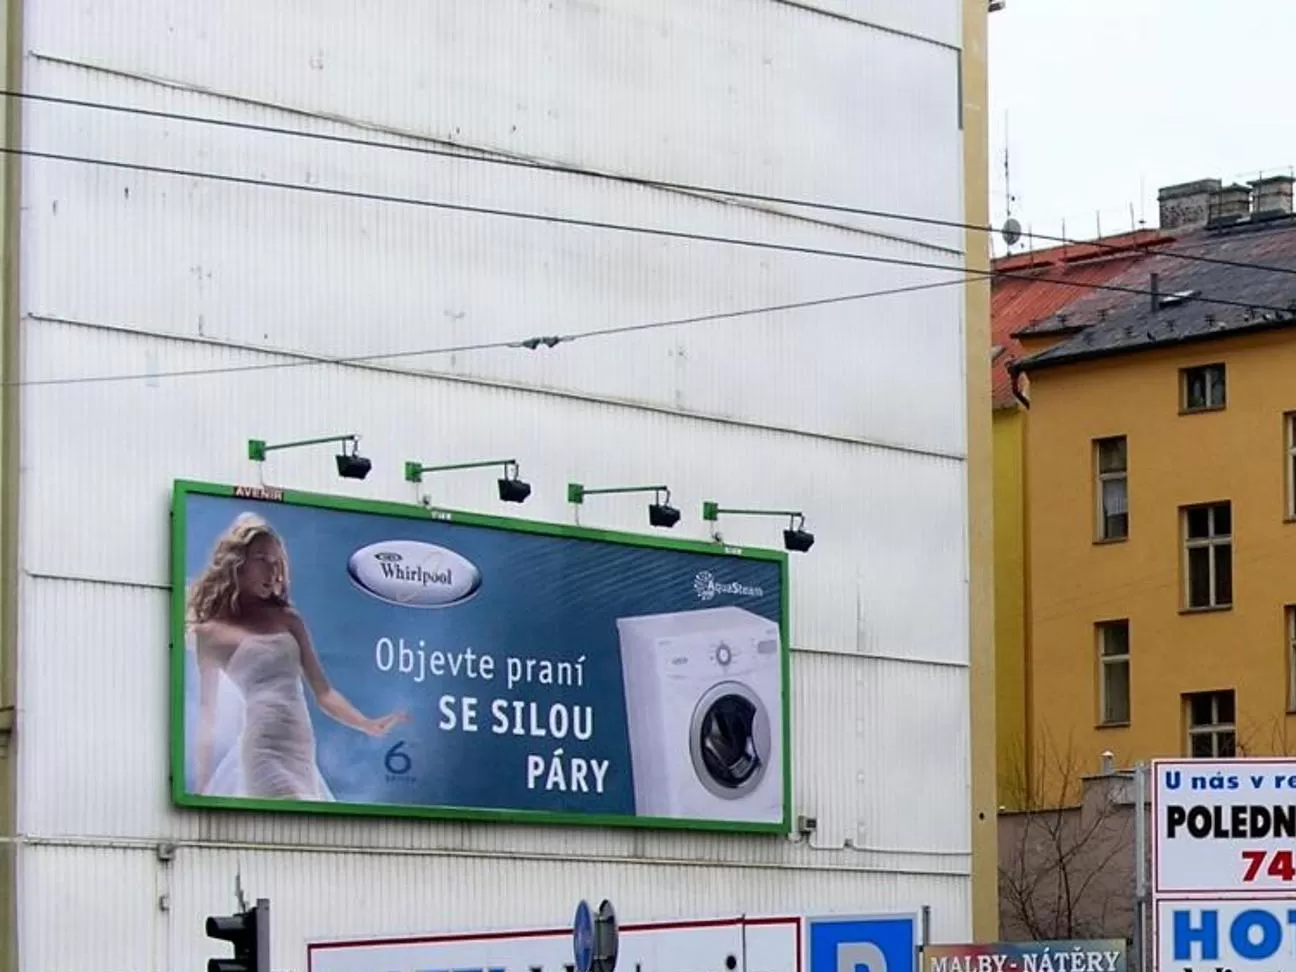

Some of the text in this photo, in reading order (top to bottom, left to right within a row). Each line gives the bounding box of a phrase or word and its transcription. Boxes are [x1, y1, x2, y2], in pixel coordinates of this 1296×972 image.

[380, 562, 453, 587] Whirlpool
[375, 636, 586, 690] Objevte praní
[439, 695, 594, 741] SE SILOU
[384, 739, 412, 774] 6
[527, 747, 610, 794] PÁRY
[1165, 771, 1181, 790] U
[1191, 771, 1239, 790] nás
[1251, 775, 1264, 789] v
